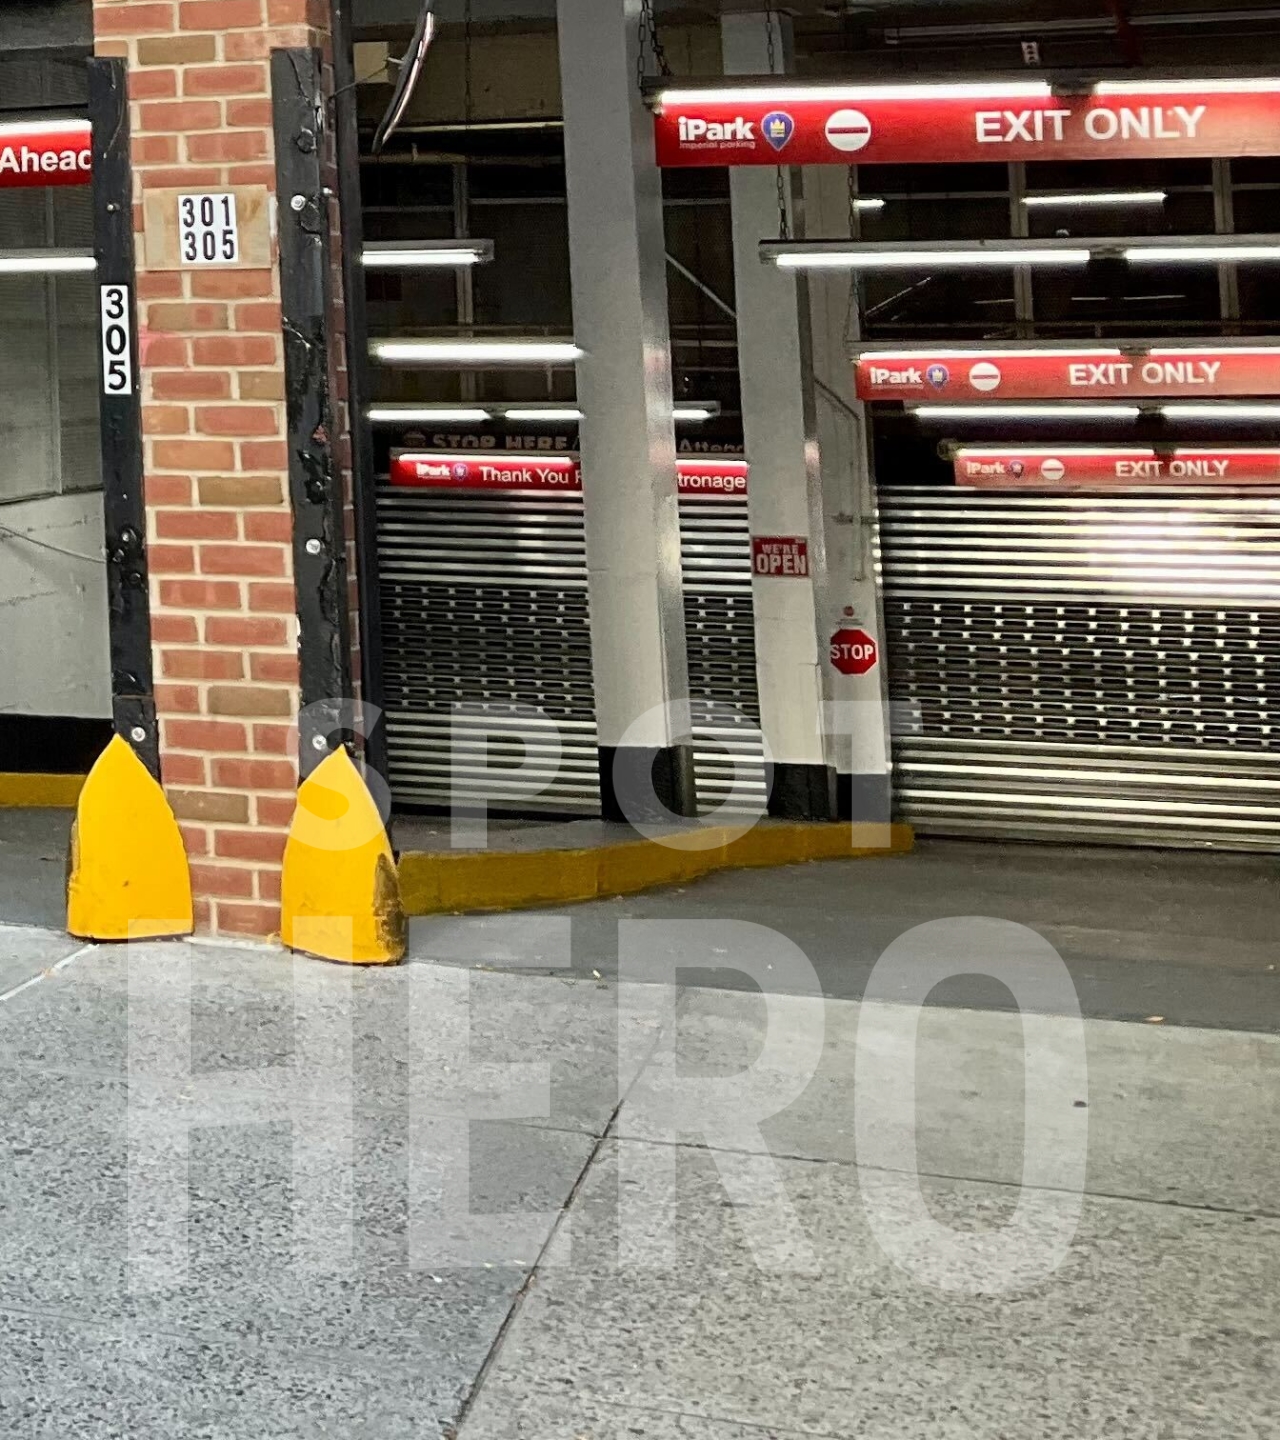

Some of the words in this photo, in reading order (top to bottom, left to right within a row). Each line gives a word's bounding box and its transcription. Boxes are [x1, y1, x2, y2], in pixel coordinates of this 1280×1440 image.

[678, 116, 755, 141] iPark
[975, 109, 1071, 143] EXIT
[1084, 105, 1207, 140] ONLY
[182, 196, 231, 227] 301
[184, 229, 235, 260] 305
[105, 288, 127, 391] 305
[870, 367, 923, 384] iPark
[1068, 363, 1133, 386] EXIT
[1142, 361, 1221, 384] ONLY
[479, 466, 533, 483] Thank
[536, 468, 570, 485] You
[678, 471, 746, 492] tronage
[1115, 461, 1165, 478] EXIT
[1169, 459, 1229, 477] ONLY
[756, 554, 807, 575] OPEN
[830, 644, 874, 660] STOP
